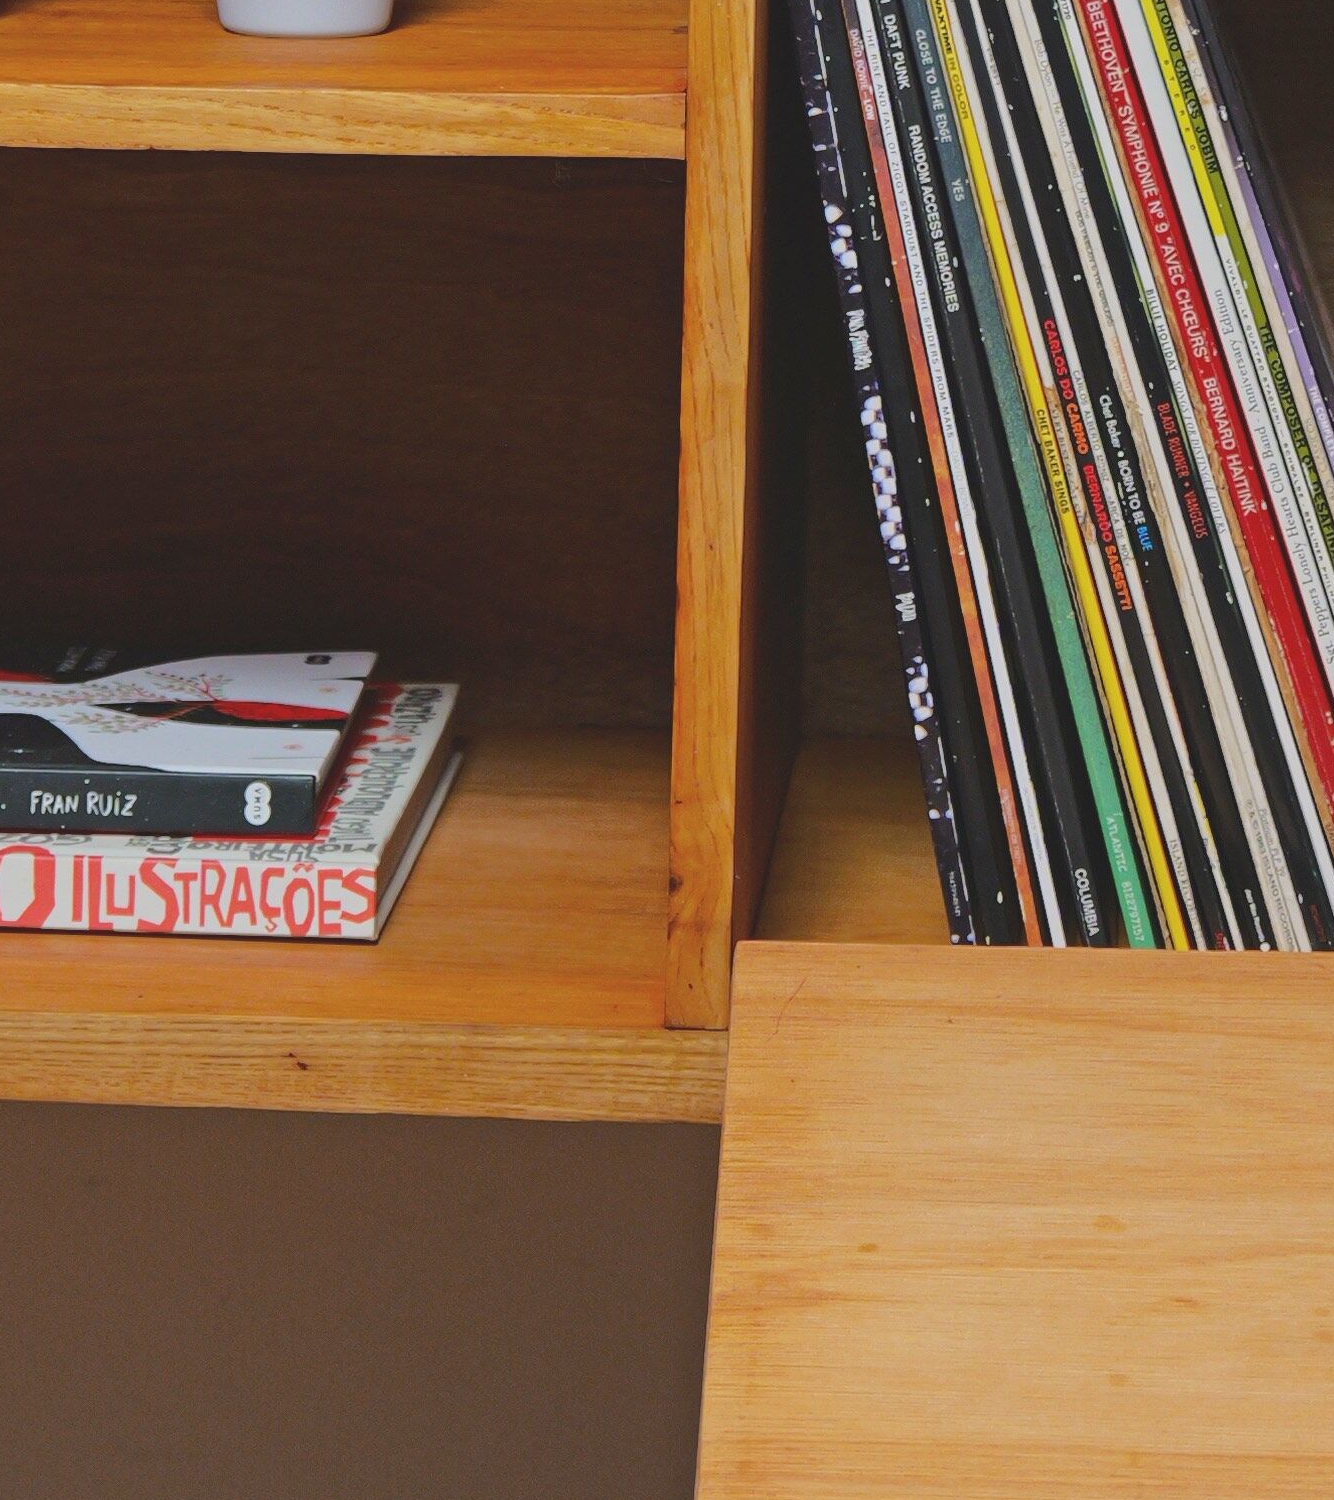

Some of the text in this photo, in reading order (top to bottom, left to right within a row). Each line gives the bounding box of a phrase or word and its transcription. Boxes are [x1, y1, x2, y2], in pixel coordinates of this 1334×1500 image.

[848, 27, 863, 57] DAVID
[864, 27, 874, 48] THE
[883, 13, 901, 50] DAFT
[1032, 38, 1045, 57] Bob
[854, 58, 869, 90] BOWIE
[869, 53, 881, 78] RISE
[891, 50, 910, 90] PUNK
[1038, 59, 1054, 87] Dylan
[875, 82, 887, 107] AND
[952, 72, 970, 120] COLOR
[881, 112, 893, 136] FALL
[914, 27, 966, 202] CLOSE TO THE EDGE YES
[1171, 57, 1203, 120] CARLOS
[1193, 124, 1220, 175] JOBIM
[887, 141, 896, 155] OF
[907, 124, 931, 184] RANDOM
[891, 160, 905, 195] ZIGGY
[899, 200, 918, 258] STARDUST
[920, 184, 943, 239] ACCESS
[912, 262, 923, 286] AND
[932, 239, 959, 313] MEMORIES
[918, 291, 928, 310] THE
[1117, 102, 1157, 199] SYMPHONIE
[1152, 221, 1168, 235] 9
[1201, 376, 1237, 451] BERNARD
[1224, 452, 1257, 516] HAITINK
[1208, 288, 1235, 336] Edition
[923, 316, 940, 365] SPIDERS
[1042, 318, 1068, 377] CARLOS
[934, 368, 947, 401] FROM
[1058, 376, 1075, 401] DO
[1224, 336, 1263, 416] Anniversary
[1308, 385, 1321, 405] THE
[1072, 369, 1088, 406] CARLOS
[1082, 408, 1100, 451] ALBERTO
[1097, 393, 1115, 419] Chet
[1144, 287, 1227, 534] BILLIE HOLIDAY SONGS FOR LOVERS
[1258, 322, 1276, 354] THE
[1269, 357, 1306, 449] COMPOSER
[1299, 453, 1315, 475] OF
[942, 405, 955, 438] MARS
[1064, 401, 1090, 456] CARMO
[1105, 418, 1124, 449] Baker
[1035, 408, 1070, 514] CHET BAKER SINGS
[1245, 324, 1265, 371] QUATTRO
[1261, 375, 1282, 425] STAGIONI
[1302, 510, 1324, 562] BERLINER
[1252, 425, 1274, 460] Band
[1116, 458, 1137, 493] BORN
[1156, 401, 1207, 540] BLADE RUNNER VANGELIS
[1264, 461, 1285, 495] Club
[1081, 463, 1113, 544] BERNARDO
[1126, 492, 1142, 510] TO
[1131, 509, 1146, 525] BE
[1275, 495, 1299, 539] Hearts
[1135, 524, 1154, 552] BLUE
[1104, 543, 1133, 612] SASSETTI
[1289, 539, 1316, 586] Lonely
[1304, 586, 1333, 638] Peppers
[30, 791, 79, 815] FRAN
[252, 788, 263, 820] SUMA
[1104, 814, 1127, 873] ATLANTIC
[1168, 838, 1186, 876] ISLAND
[1260, 854, 1280, 898] ISLAND
[1073, 867, 1100, 936] COLUMBIA
